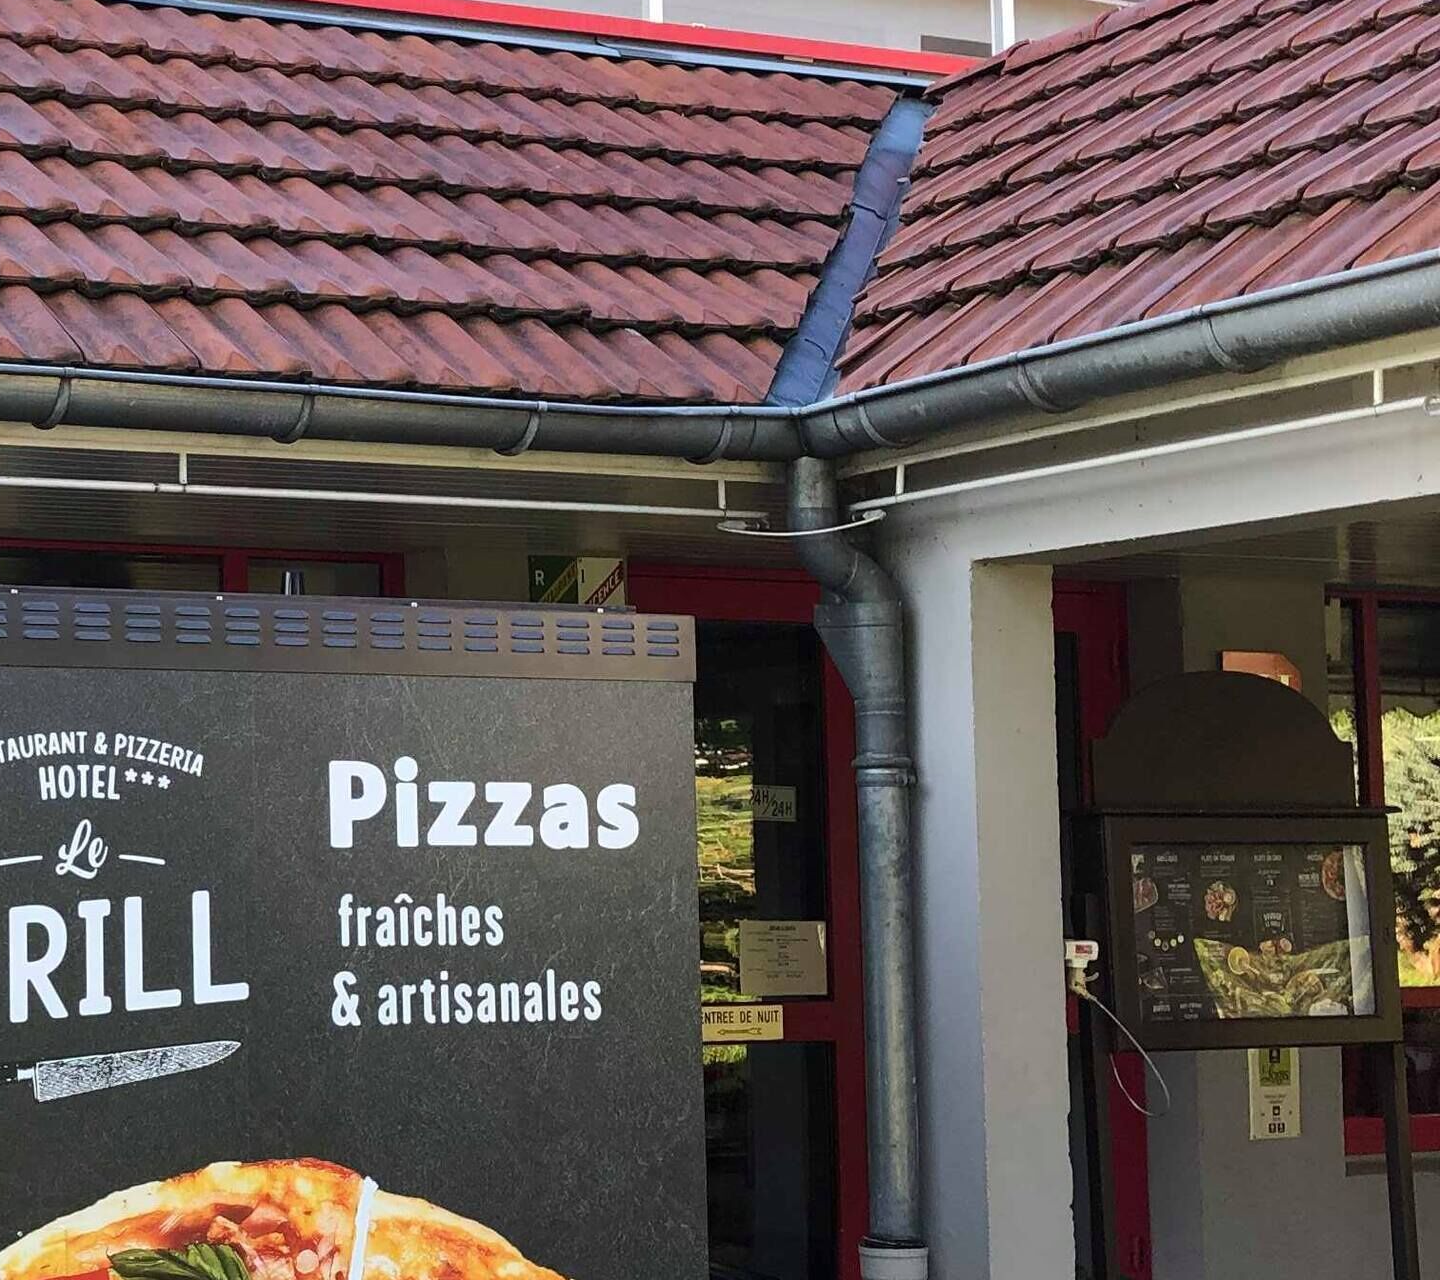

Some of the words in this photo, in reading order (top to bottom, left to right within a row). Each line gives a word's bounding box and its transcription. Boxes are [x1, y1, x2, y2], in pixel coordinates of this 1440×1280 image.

[94, 731, 109, 756] &
[114, 732, 205, 777] PIZZERIA
[328, 755, 641, 850] Pizzas
[55, 818, 110, 880] Le
[338, 892, 505, 948] fraîches
[330, 970, 362, 1027] &
[377, 968, 603, 1026] artisanales
[739, 1010, 752, 1024] DE
[757, 1009, 779, 1024] NUIT
